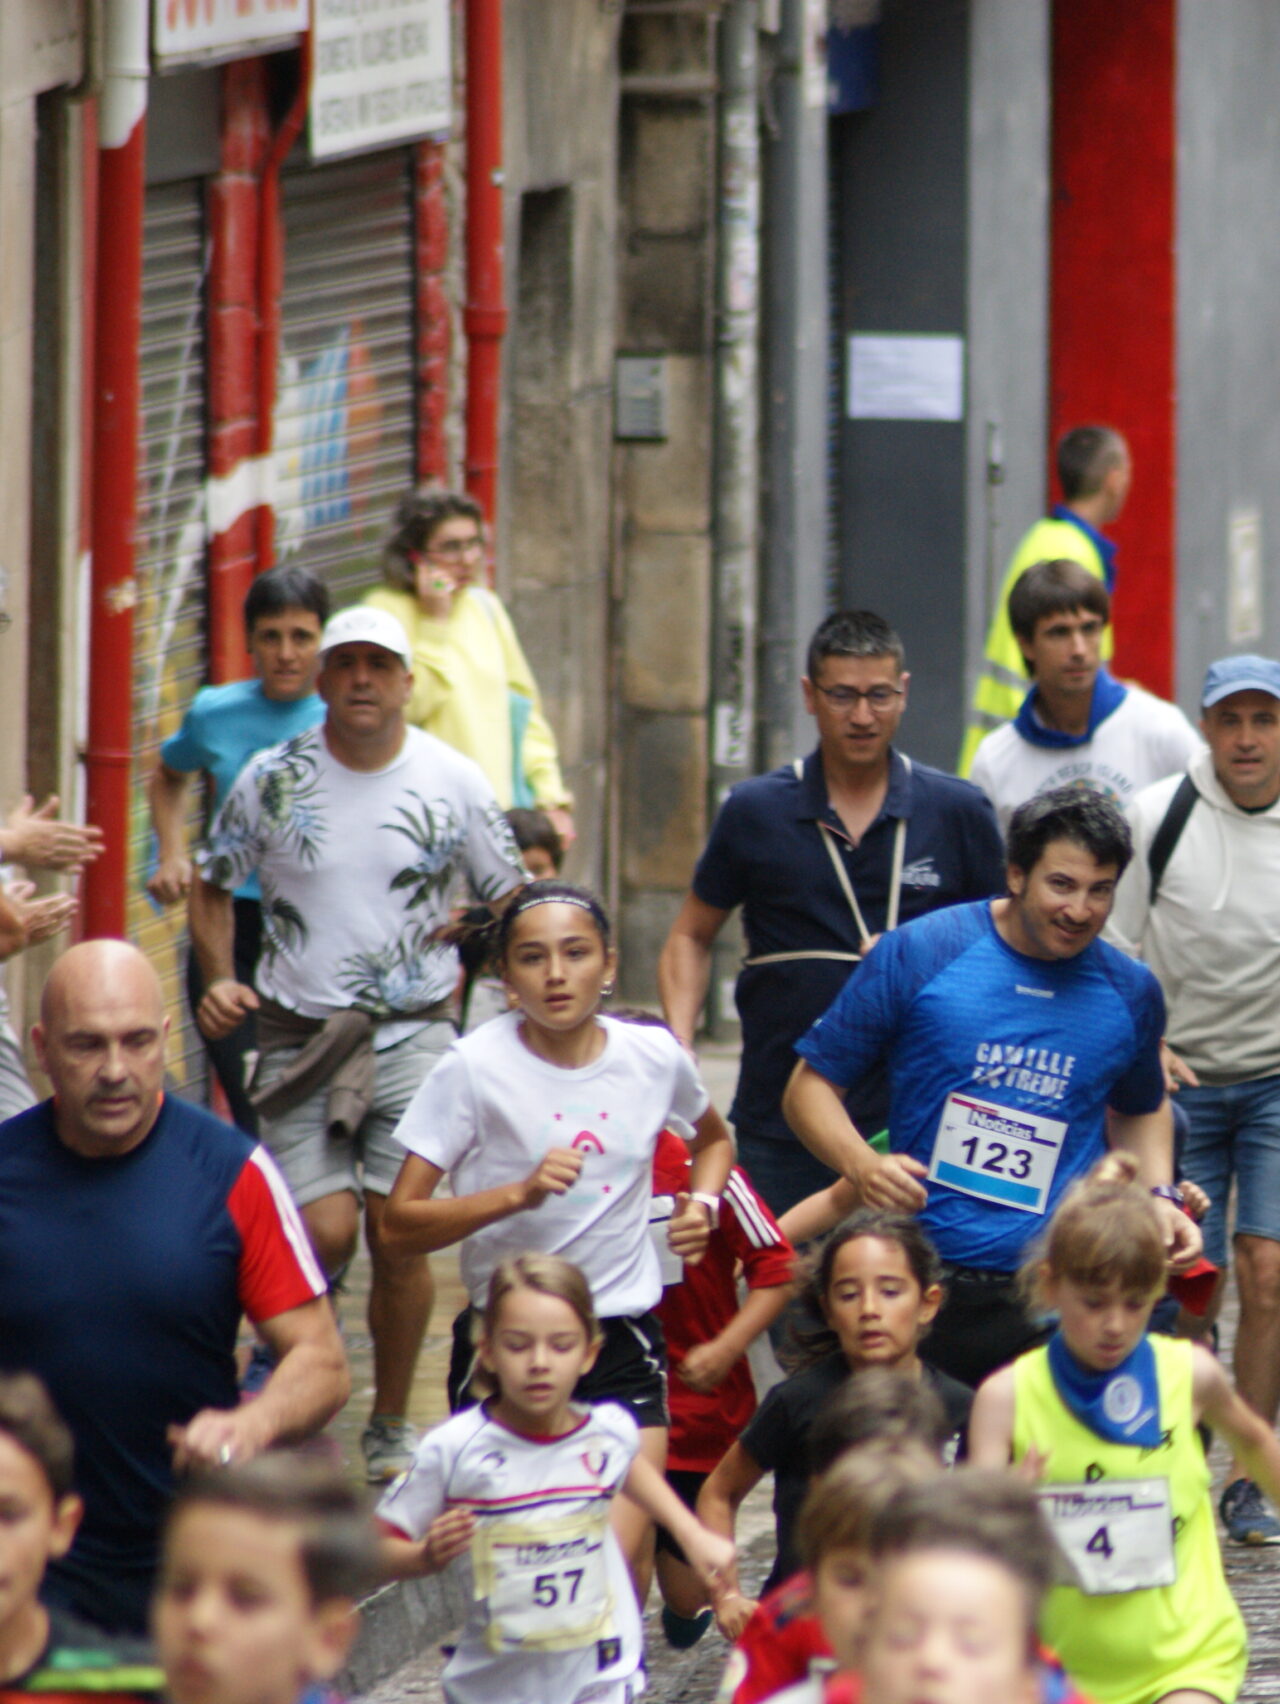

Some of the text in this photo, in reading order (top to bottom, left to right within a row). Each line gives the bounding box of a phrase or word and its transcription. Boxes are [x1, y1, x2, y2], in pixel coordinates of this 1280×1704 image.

[968, 1109, 1035, 1141] Noticias
[960, 1136, 1033, 1180] 123
[1086, 1524, 1115, 1560] 4
[531, 1567, 585, 1609] 57
